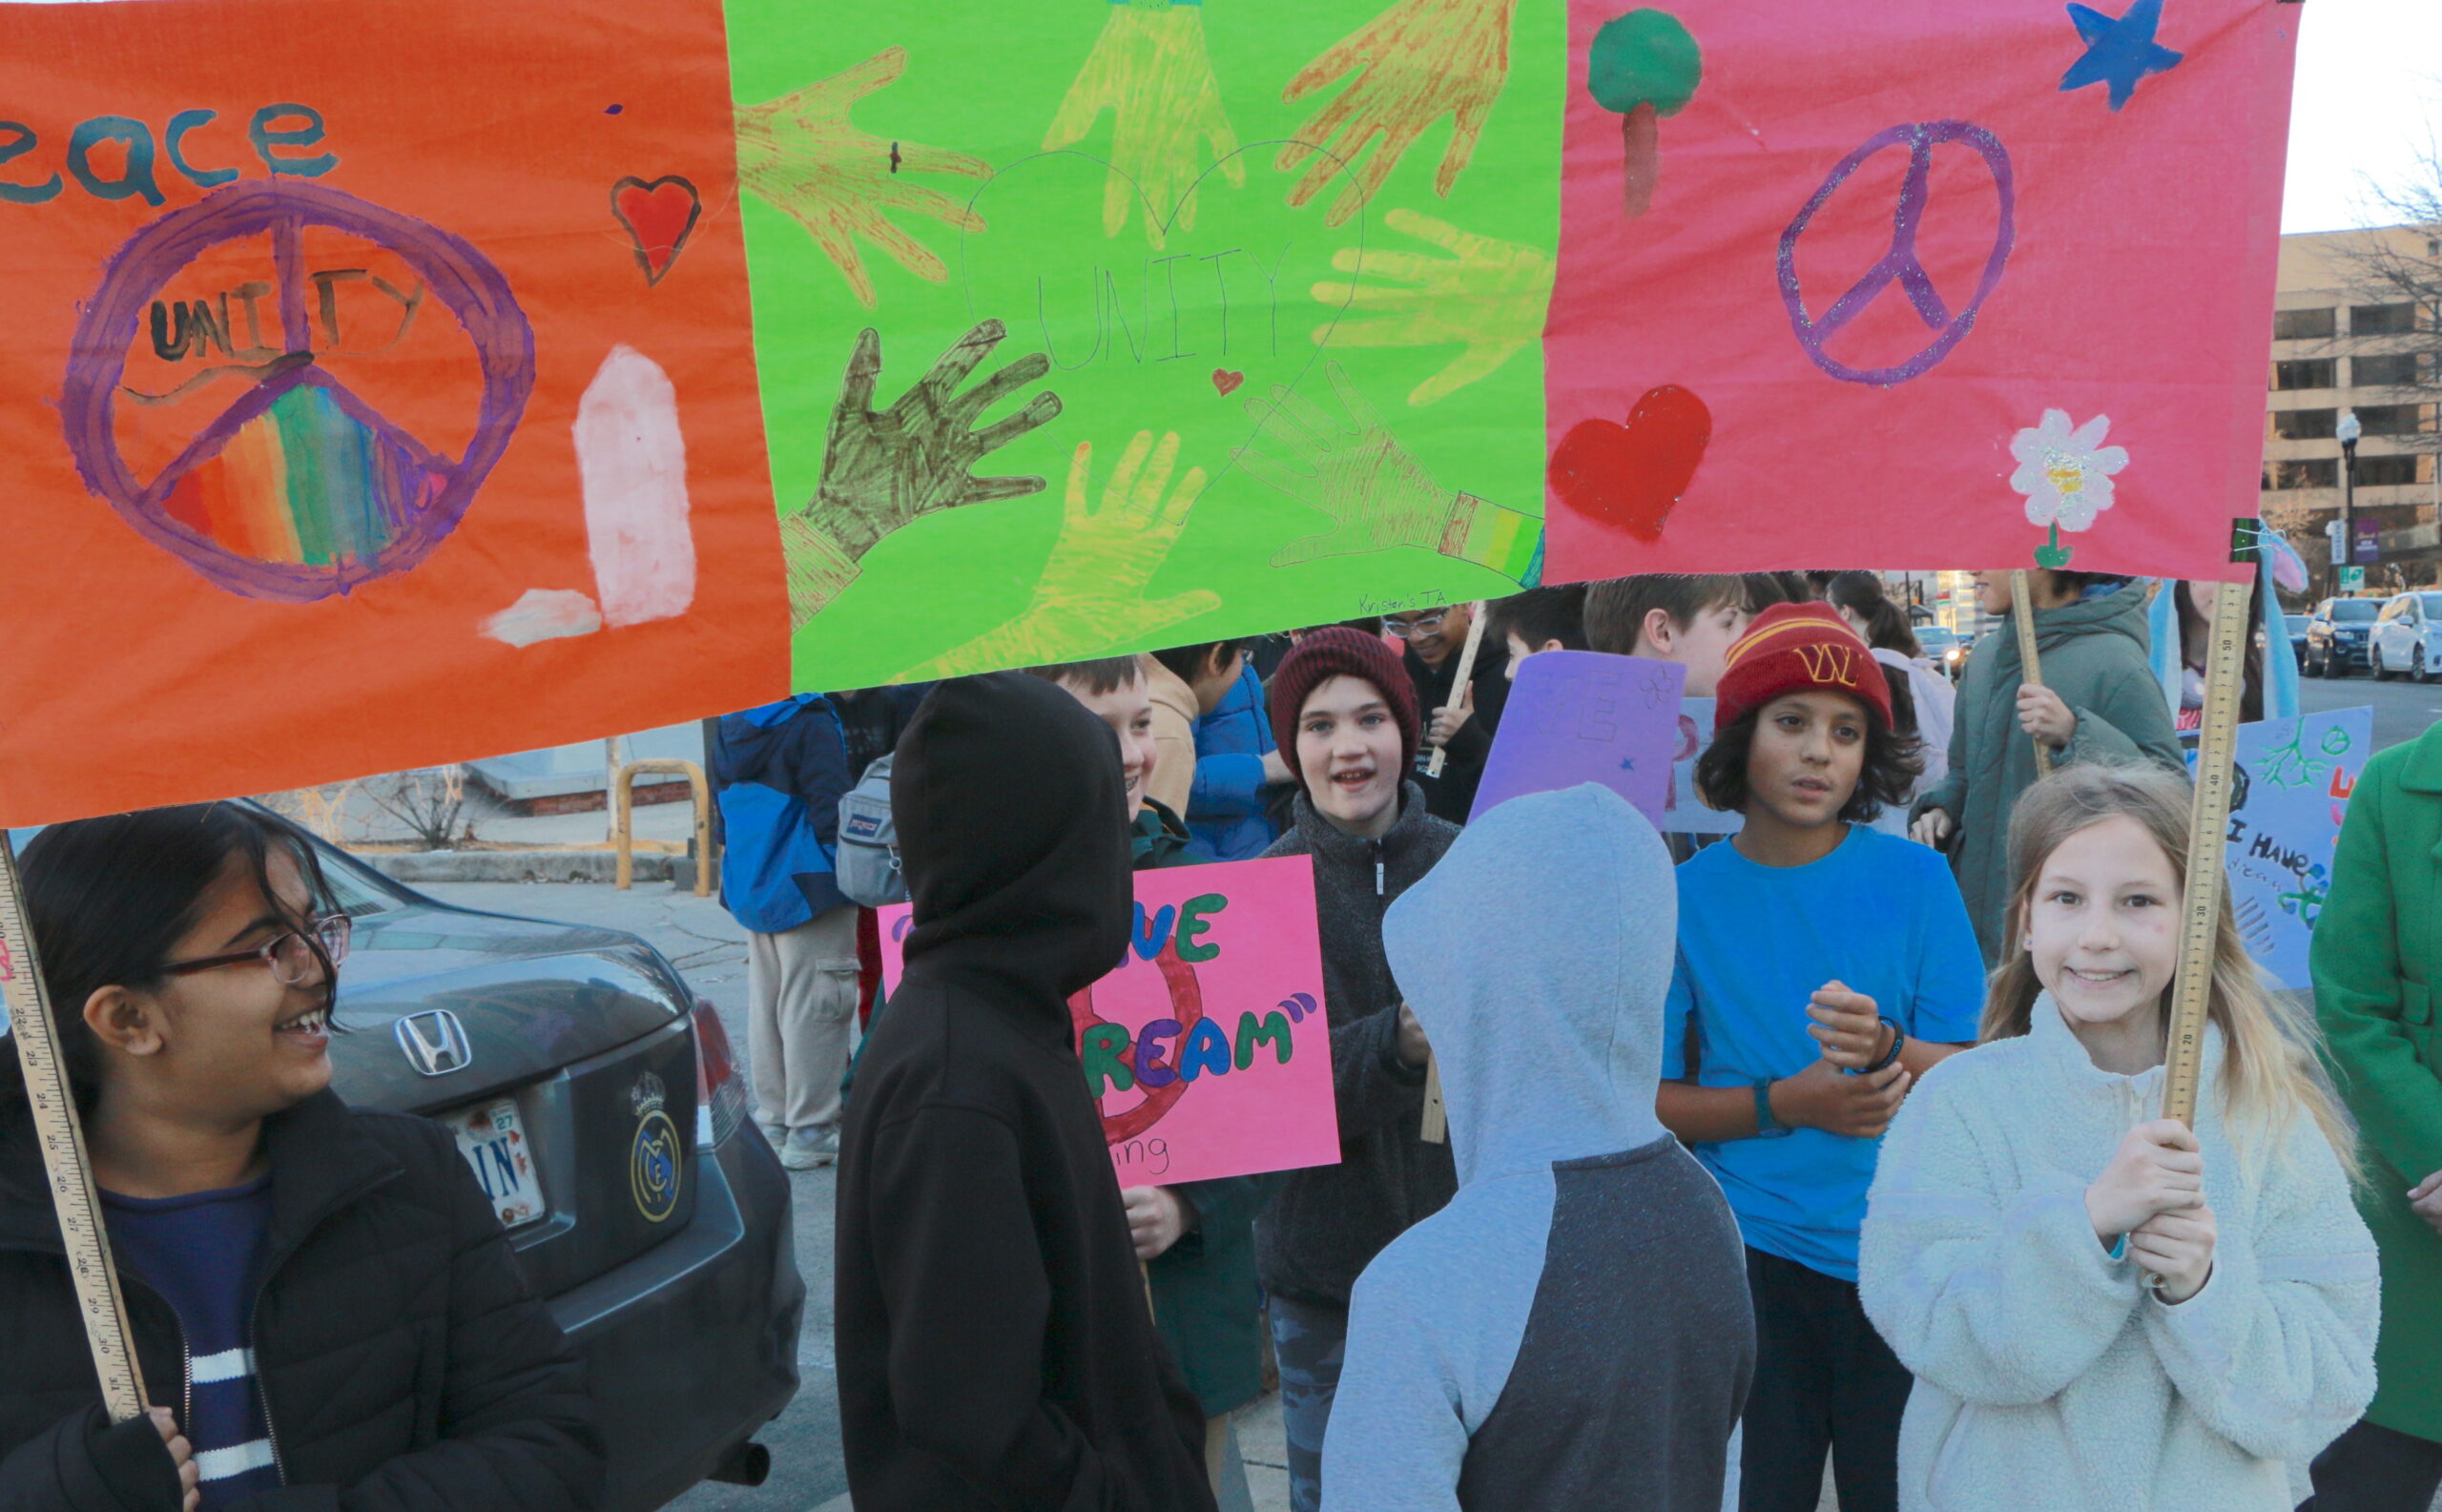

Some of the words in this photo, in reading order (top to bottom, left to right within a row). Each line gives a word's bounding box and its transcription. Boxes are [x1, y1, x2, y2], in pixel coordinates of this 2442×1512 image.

[0, 102, 341, 207] eace
[150, 267, 424, 362] UNITY
[1038, 240, 1293, 371] UNITY
[1419, 589, 1447, 606] TA
[2183, 1033, 2193, 1046] 20
[2196, 905, 2206, 917] 30
[2209, 774, 2220, 786] 40
[2222, 639, 2232, 652] 50
[1113, 893, 1229, 967] VE
[495, 1114, 513, 1130] 27
[14, 1007, 28, 1026] 22
[25, 1050, 38, 1067] 23
[36, 1093, 49, 1110] 24
[46, 1134, 59, 1151] 25
[56, 1175, 70, 1193] 26
[66, 1216, 79, 1232] 27
[76, 1257, 90, 1276] 28
[87, 1297, 100, 1315] 29
[97, 1338, 111, 1355] 30
[108, 1376, 121, 1392] 31
